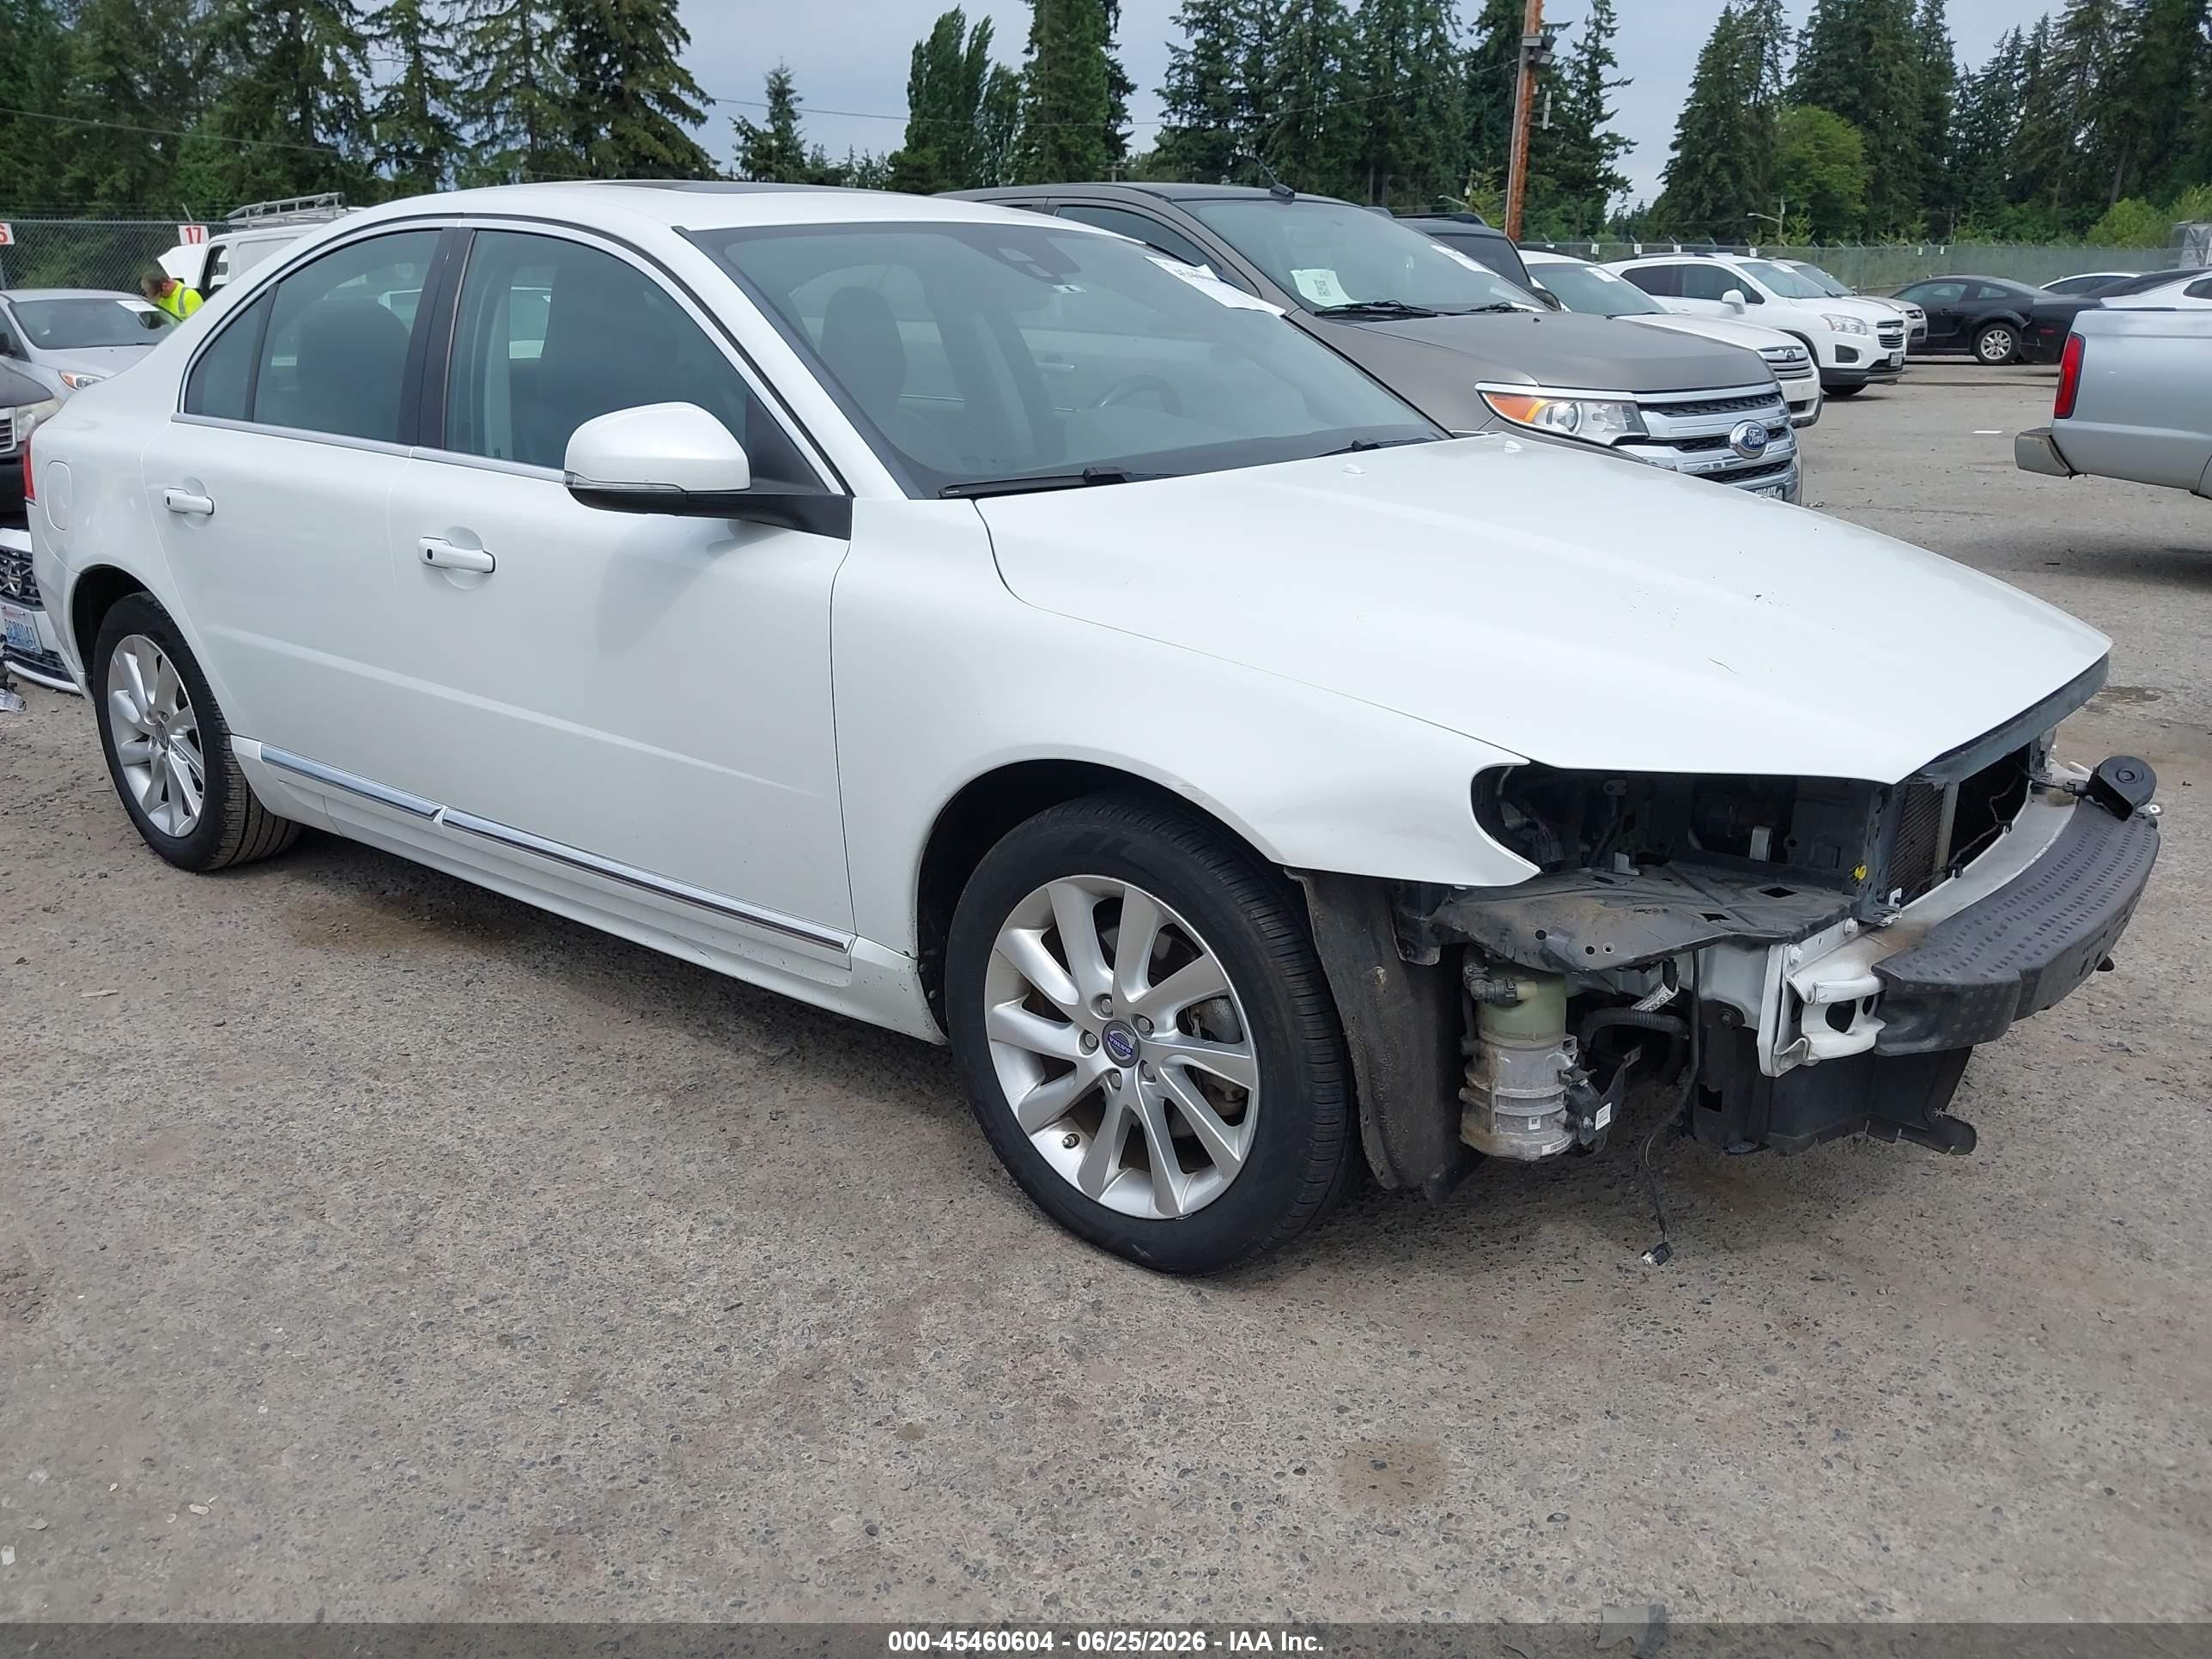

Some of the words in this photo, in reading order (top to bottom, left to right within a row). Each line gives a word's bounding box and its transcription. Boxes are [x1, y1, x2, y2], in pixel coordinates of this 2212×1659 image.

[185, 227, 202, 244] 17
[1747, 428, 1765, 446] Ford
[1109, 1035, 1132, 1054] VOLVO
